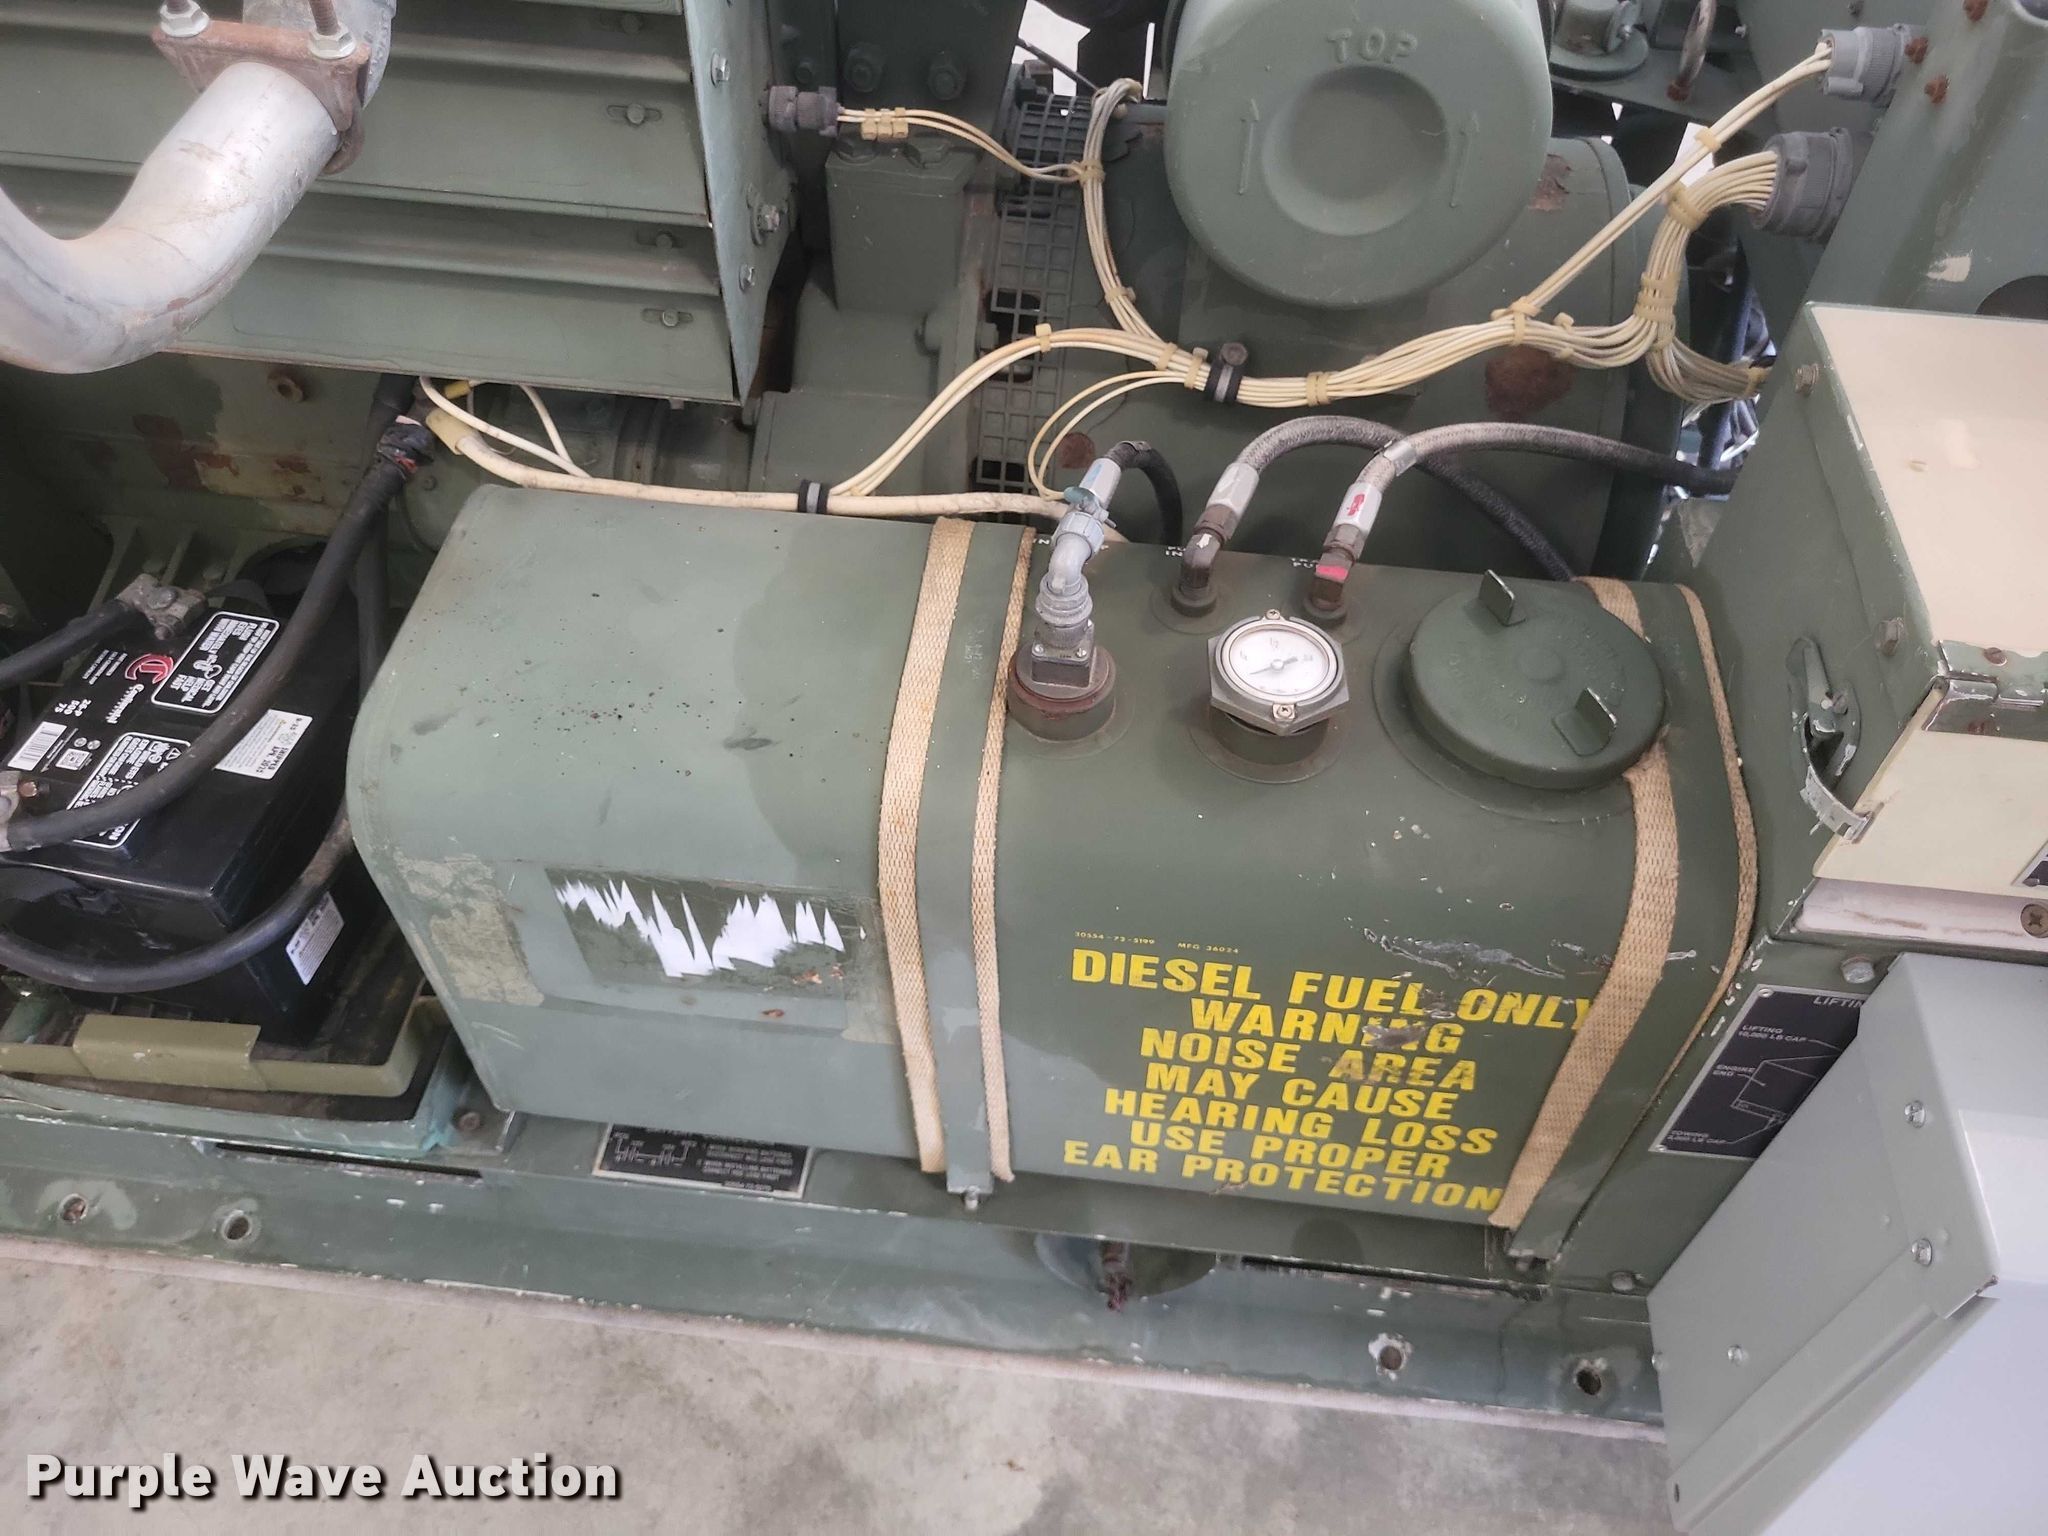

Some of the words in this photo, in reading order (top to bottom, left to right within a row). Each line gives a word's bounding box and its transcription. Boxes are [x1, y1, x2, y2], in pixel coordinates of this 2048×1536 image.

[1326, 27, 1419, 64] TOP
[1071, 948, 1261, 1000] DIESEL
[1288, 970, 1425, 1016] FUEL
[1456, 987, 1592, 1031] ONLY
[1140, 1027, 1301, 1074] NOISE
[1328, 1048, 1477, 1091] AREA
[1145, 1062, 1260, 1100] MAY
[1281, 1077, 1459, 1120] CAUSE
[1104, 1087, 1334, 1139] HEARING
[1360, 1117, 1498, 1154] LOSS
[1130, 1120, 1226, 1156] USE
[1250, 1134, 1450, 1179] PROPER
[1063, 1139, 1158, 1174] EAR
[1181, 1153, 1503, 1211] PROTECTION
